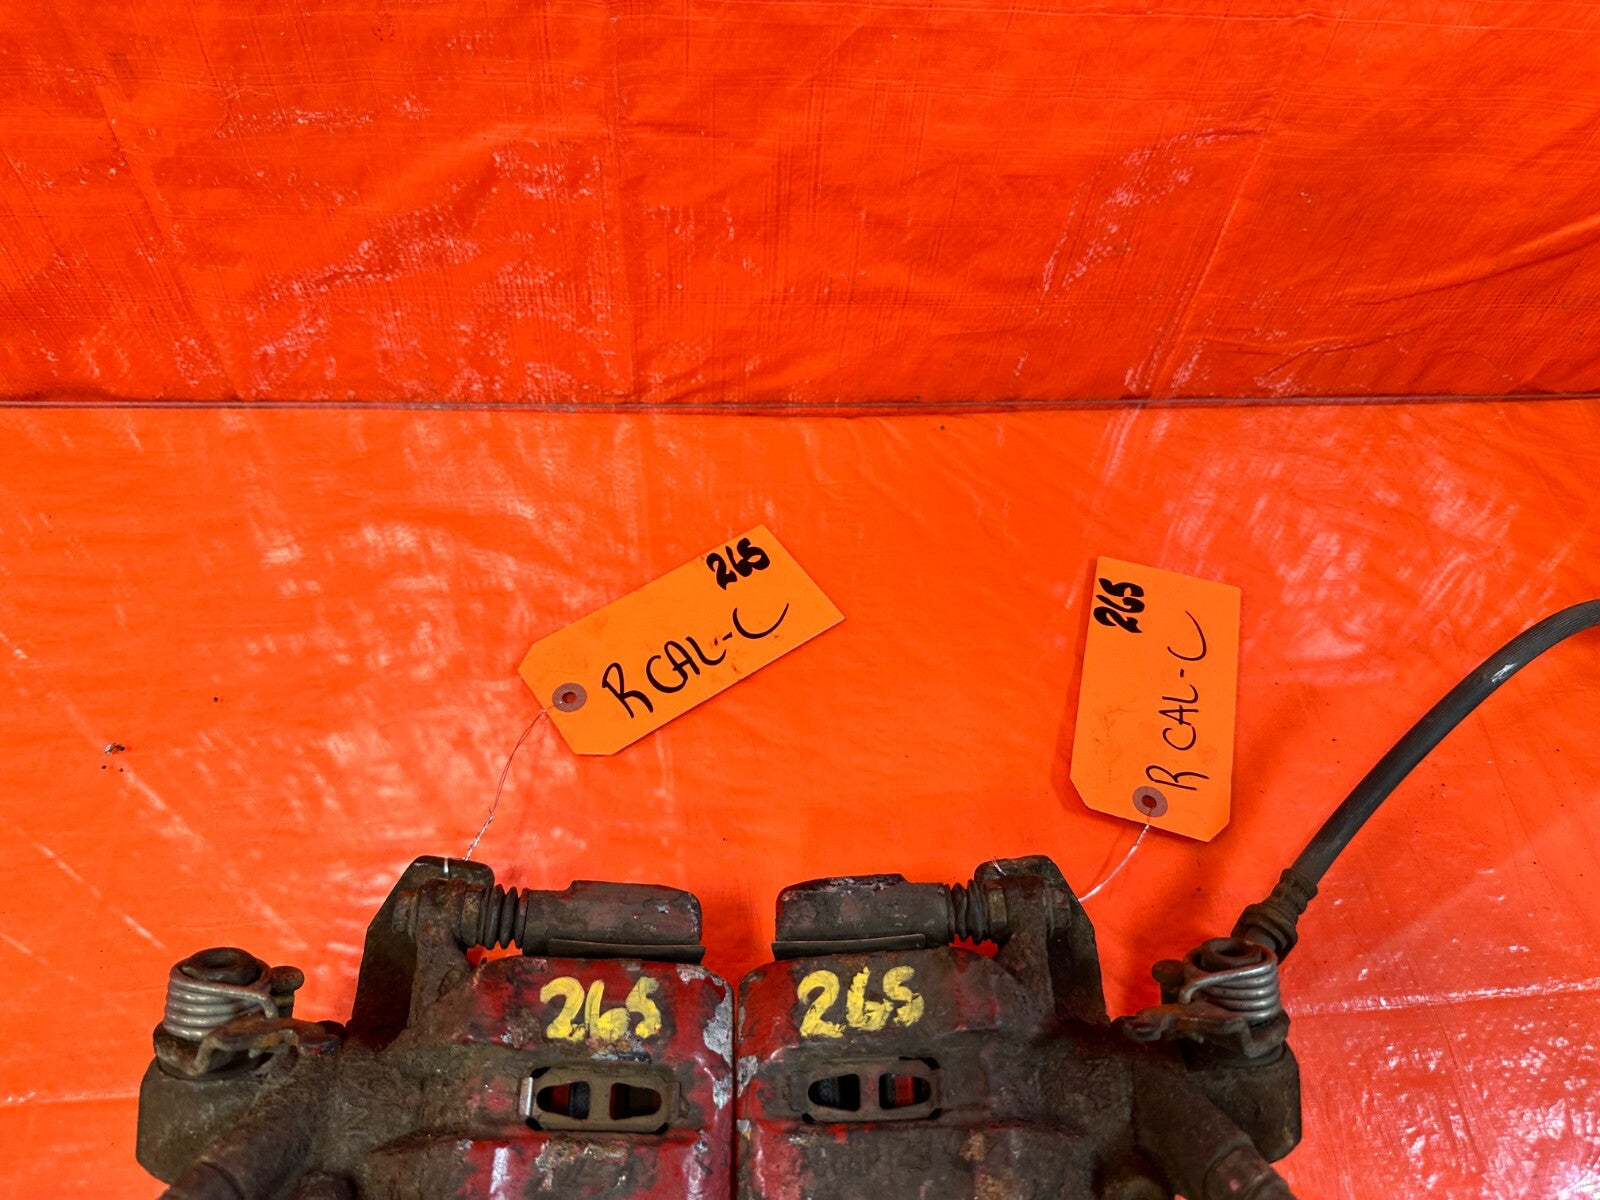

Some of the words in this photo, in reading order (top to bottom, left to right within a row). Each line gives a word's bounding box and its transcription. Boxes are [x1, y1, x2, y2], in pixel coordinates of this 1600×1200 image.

[706, 537, 770, 590] 265
[1093, 577, 1145, 633] 265
[601, 662, 654, 719] R
[1145, 764, 1210, 791] R
[539, 976, 661, 1042] 265
[798, 965, 925, 1038] 265
